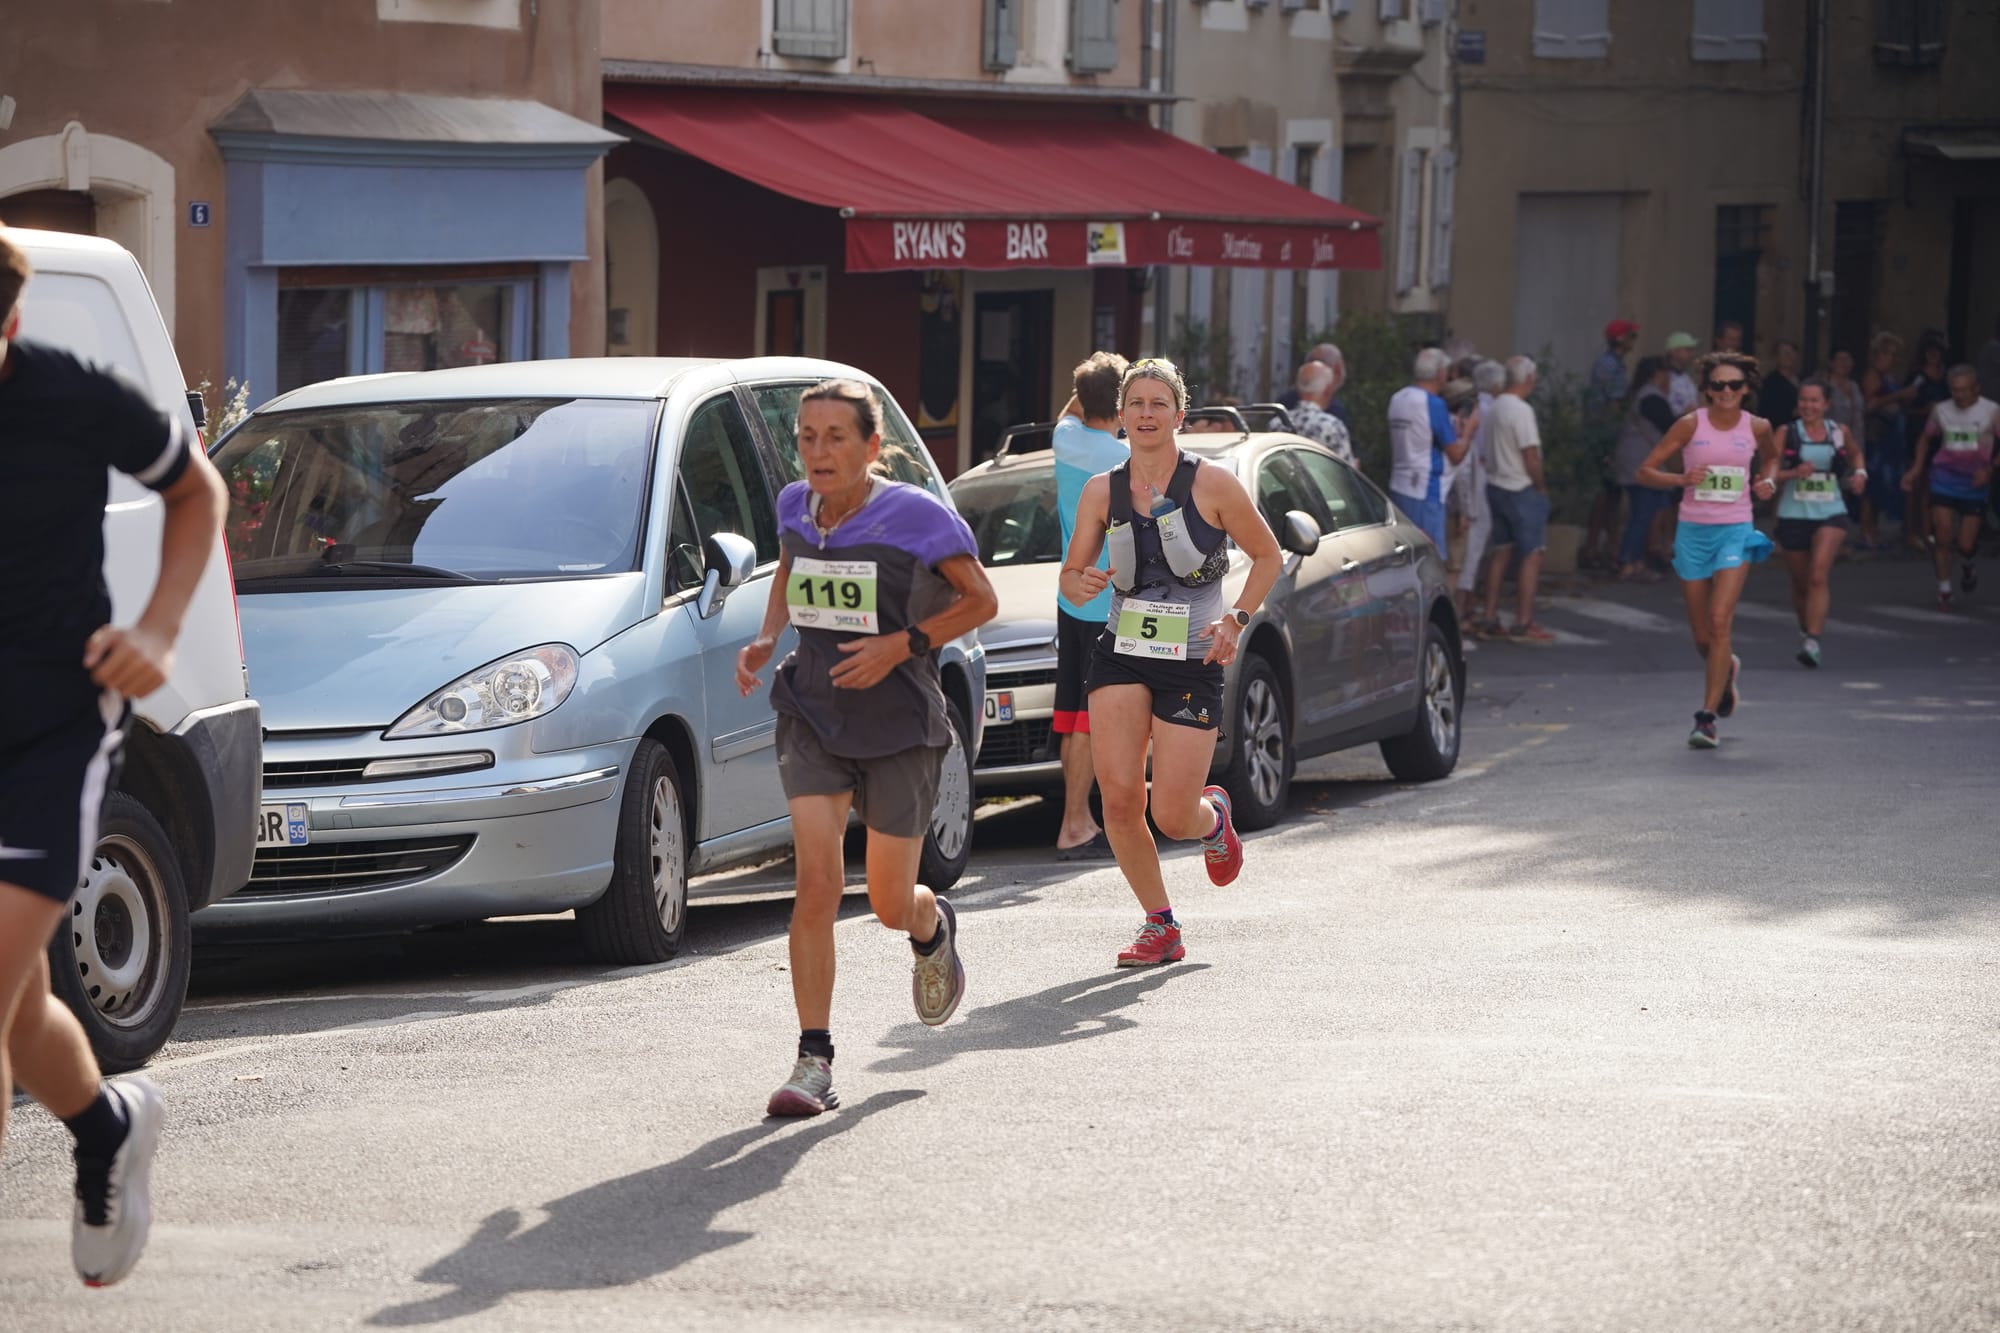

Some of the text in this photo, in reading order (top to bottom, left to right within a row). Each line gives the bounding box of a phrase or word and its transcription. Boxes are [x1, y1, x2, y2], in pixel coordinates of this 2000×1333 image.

[196, 206, 204, 223] 6
[893, 221, 966, 260] RYAN'S
[1006, 223, 1048, 260] BAR
[1168, 225, 1194, 257] Chez
[1708, 475, 1732, 490] 18
[799, 578, 862, 609] 119
[1140, 617, 1158, 639] 5
[1001, 707, 1011, 719] 48
[290, 825, 305, 839] 59
